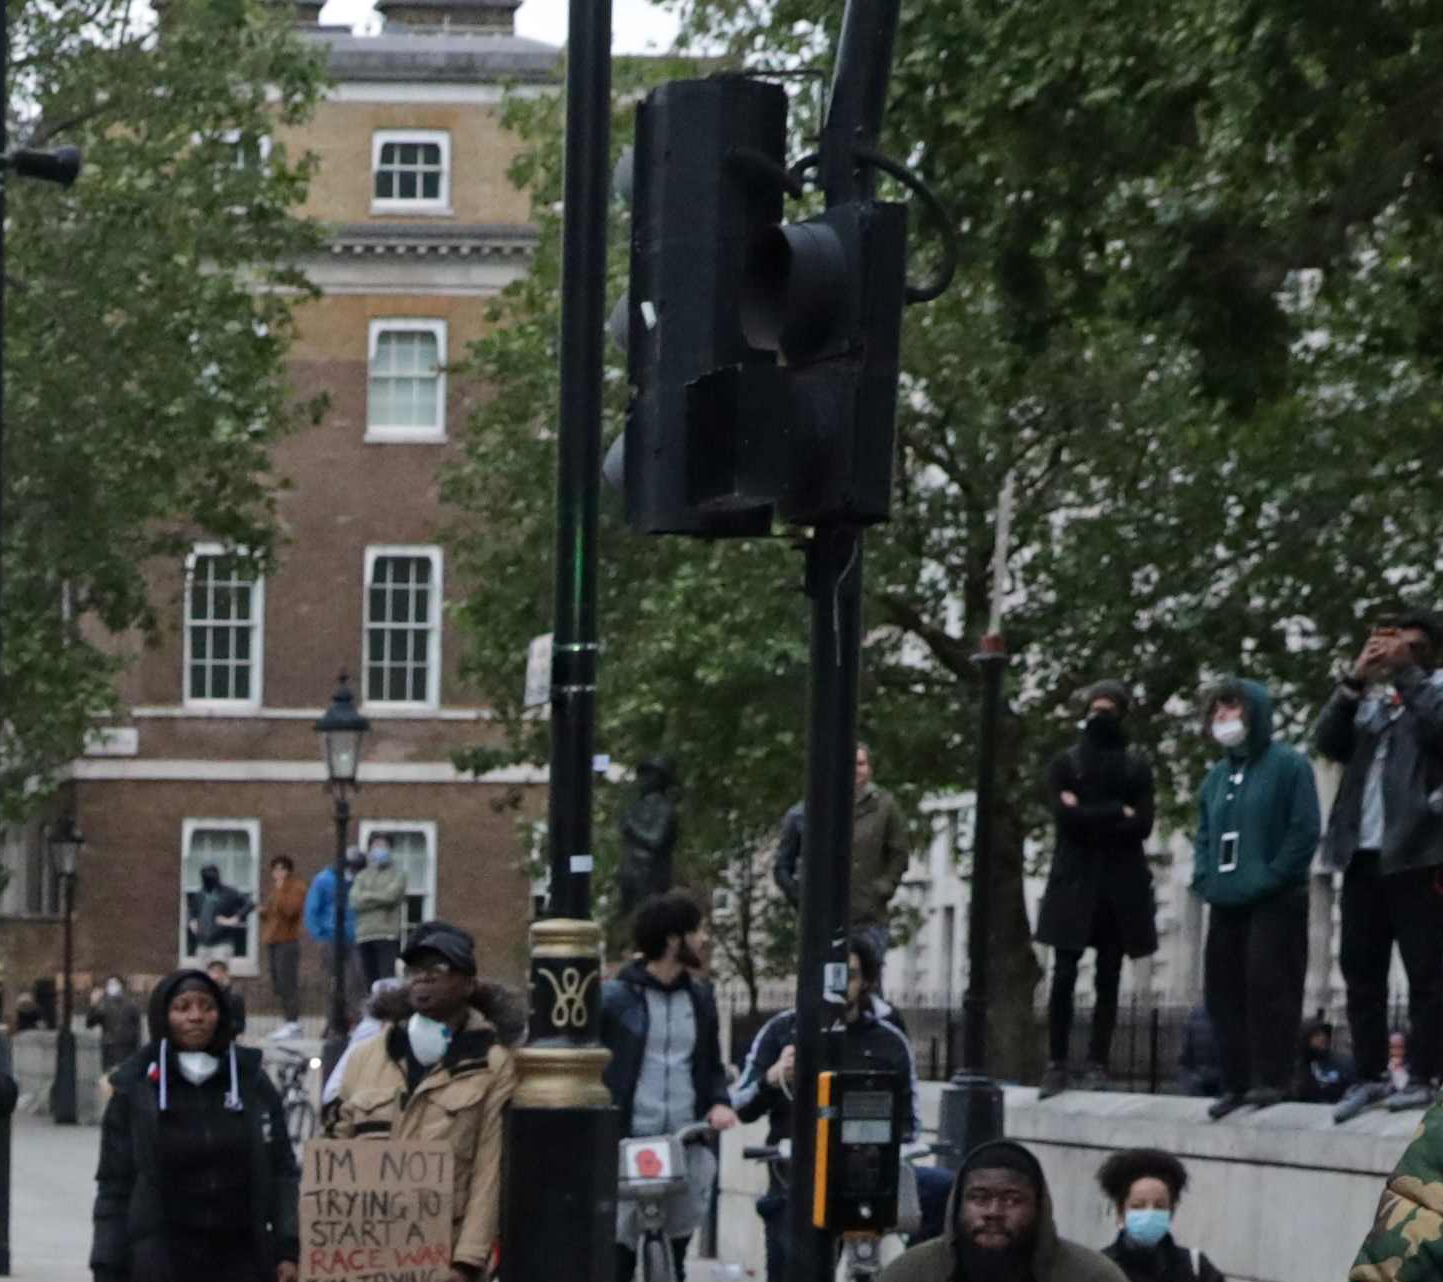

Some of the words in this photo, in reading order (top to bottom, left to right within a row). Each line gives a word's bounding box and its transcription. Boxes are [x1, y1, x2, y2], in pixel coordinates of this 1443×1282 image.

[314, 1149, 356, 1183] I'M
[380, 1151, 447, 1183] NOT
[304, 1188, 408, 1220] TRYING
[416, 1190, 442, 1219] TO
[310, 1220, 396, 1247] START
[405, 1221, 426, 1245] A
[307, 1248, 384, 1274] RACE
[396, 1244, 451, 1268] WAR
